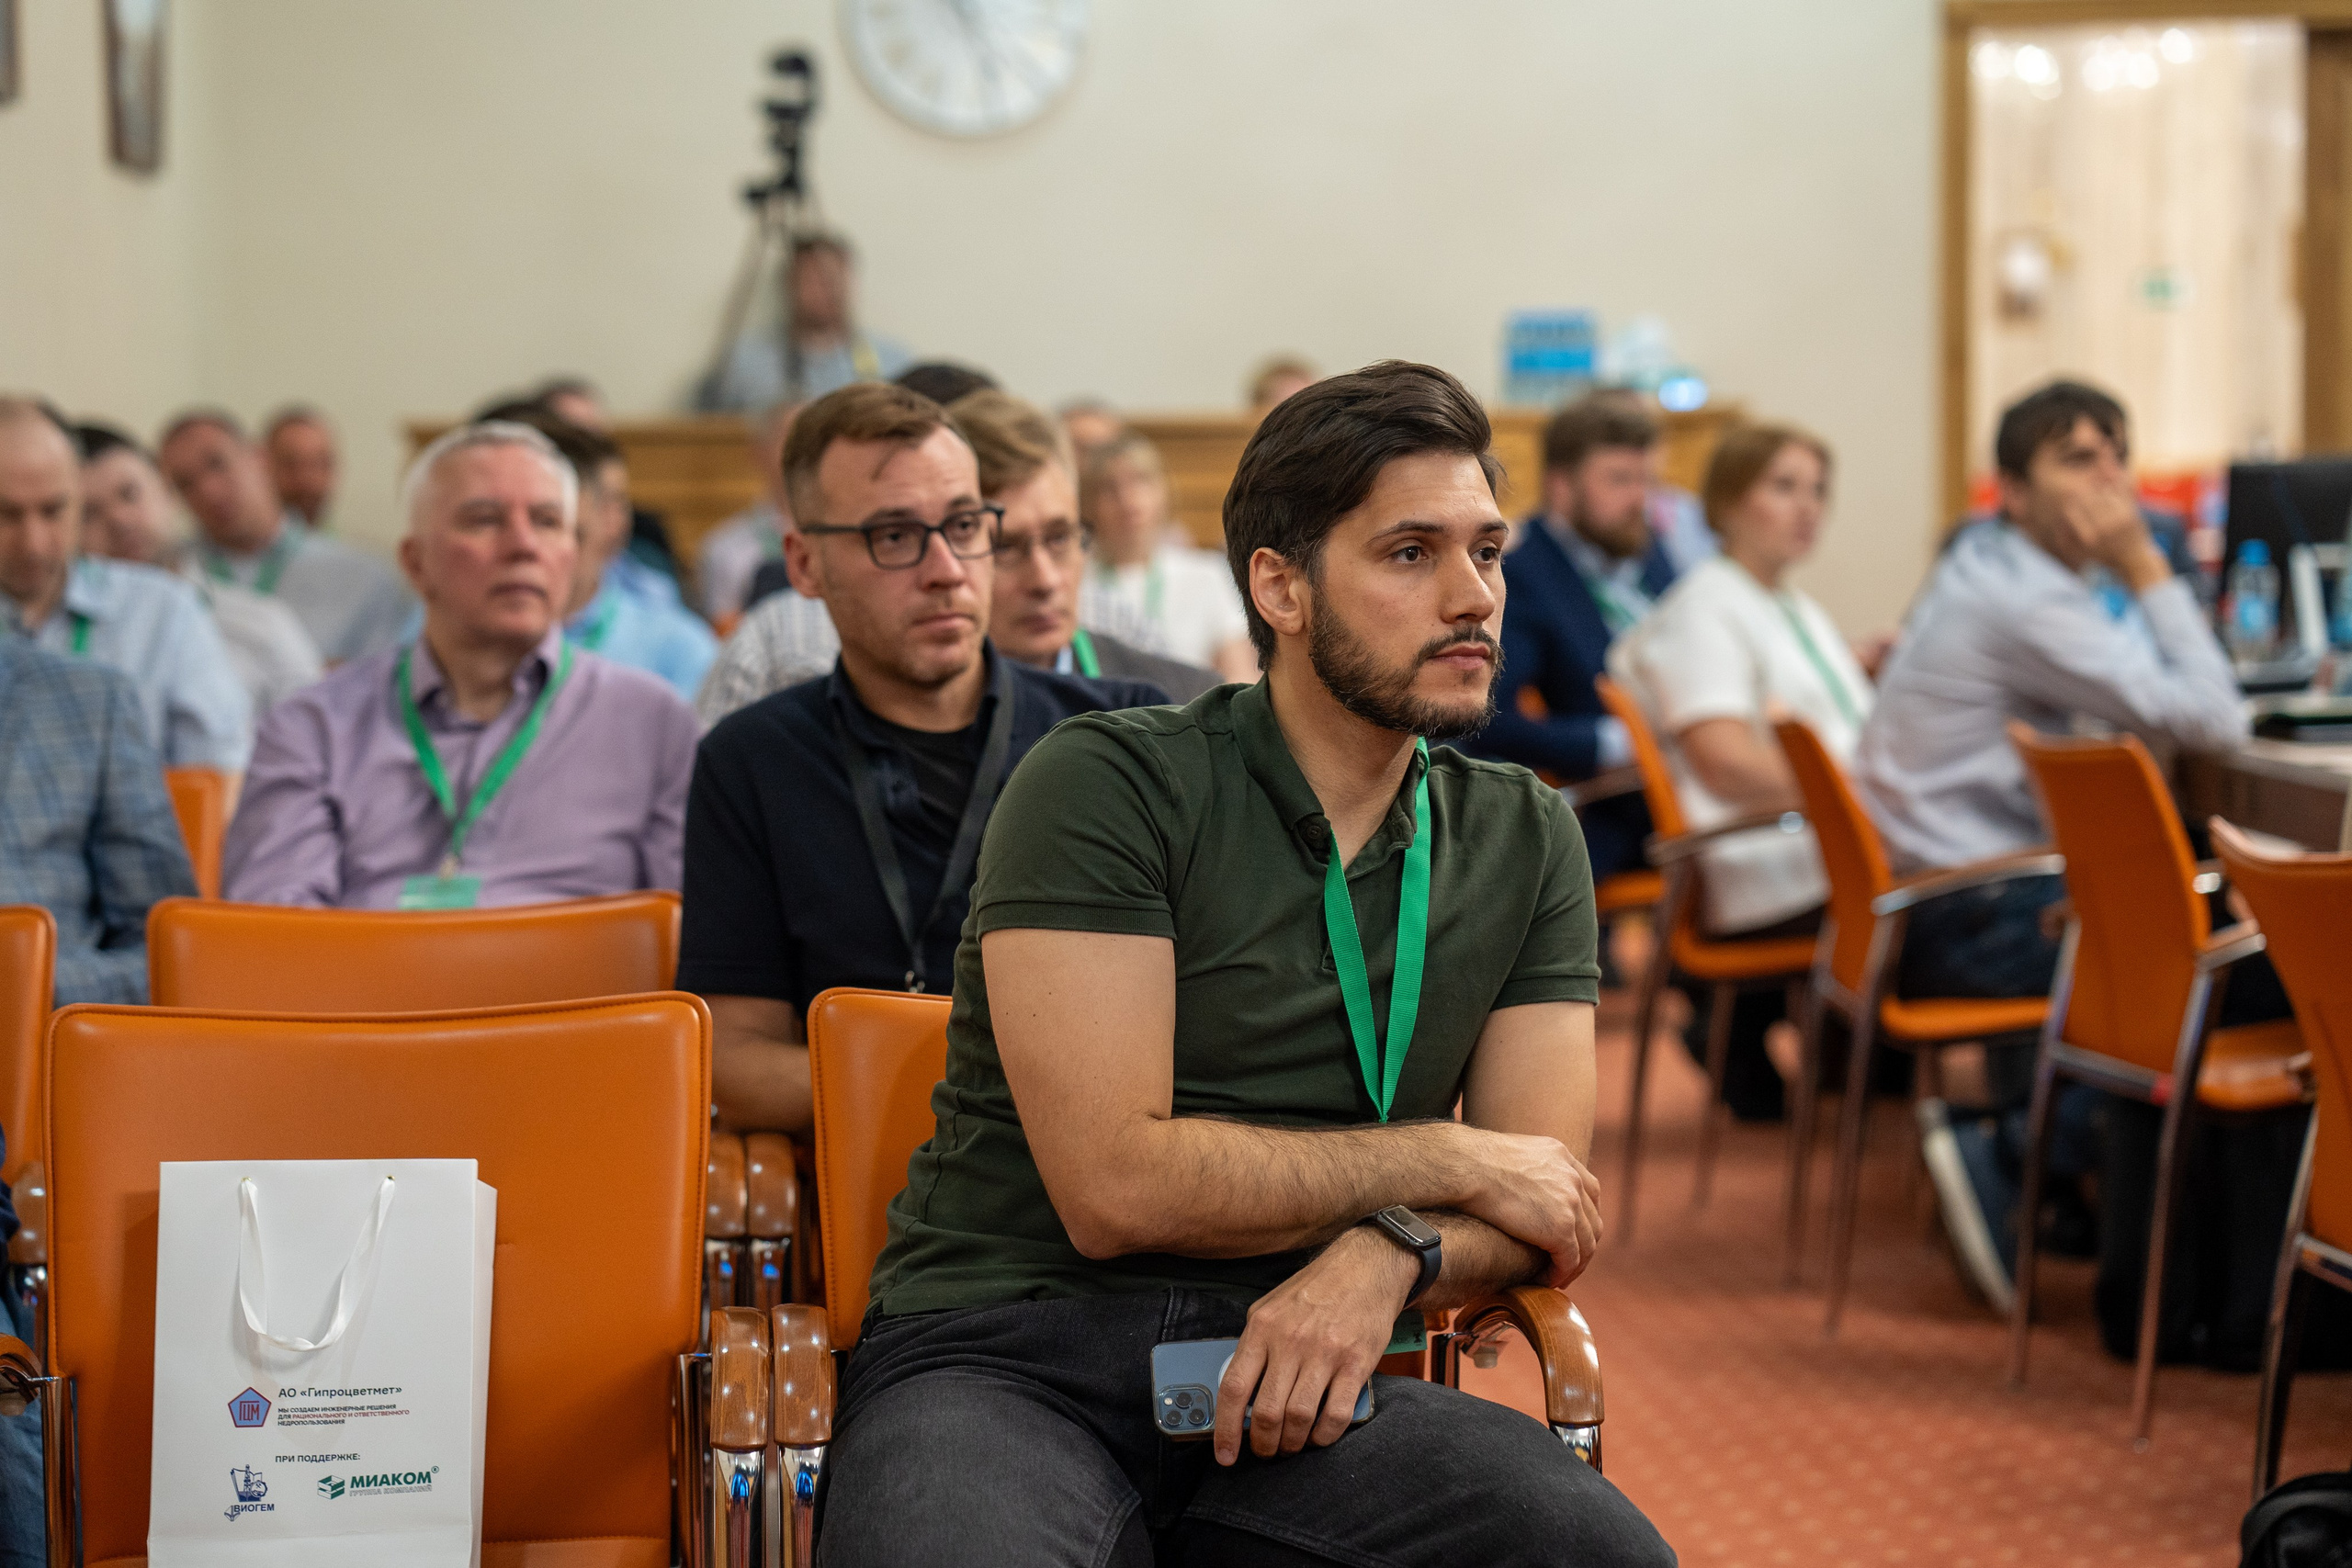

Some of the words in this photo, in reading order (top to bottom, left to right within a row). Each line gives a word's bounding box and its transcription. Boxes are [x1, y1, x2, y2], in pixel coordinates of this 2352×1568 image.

[278, 1388, 297, 1398] АО
[300, 1387, 402, 1399] «Гипроцветмет»
[354, 1409, 410, 1417] ОТВЕТСТВЕННОГО
[297, 1453, 360, 1463] ПОДДЕРЖКЕ:
[233, 1503, 275, 1513] ВИОГЕМ
